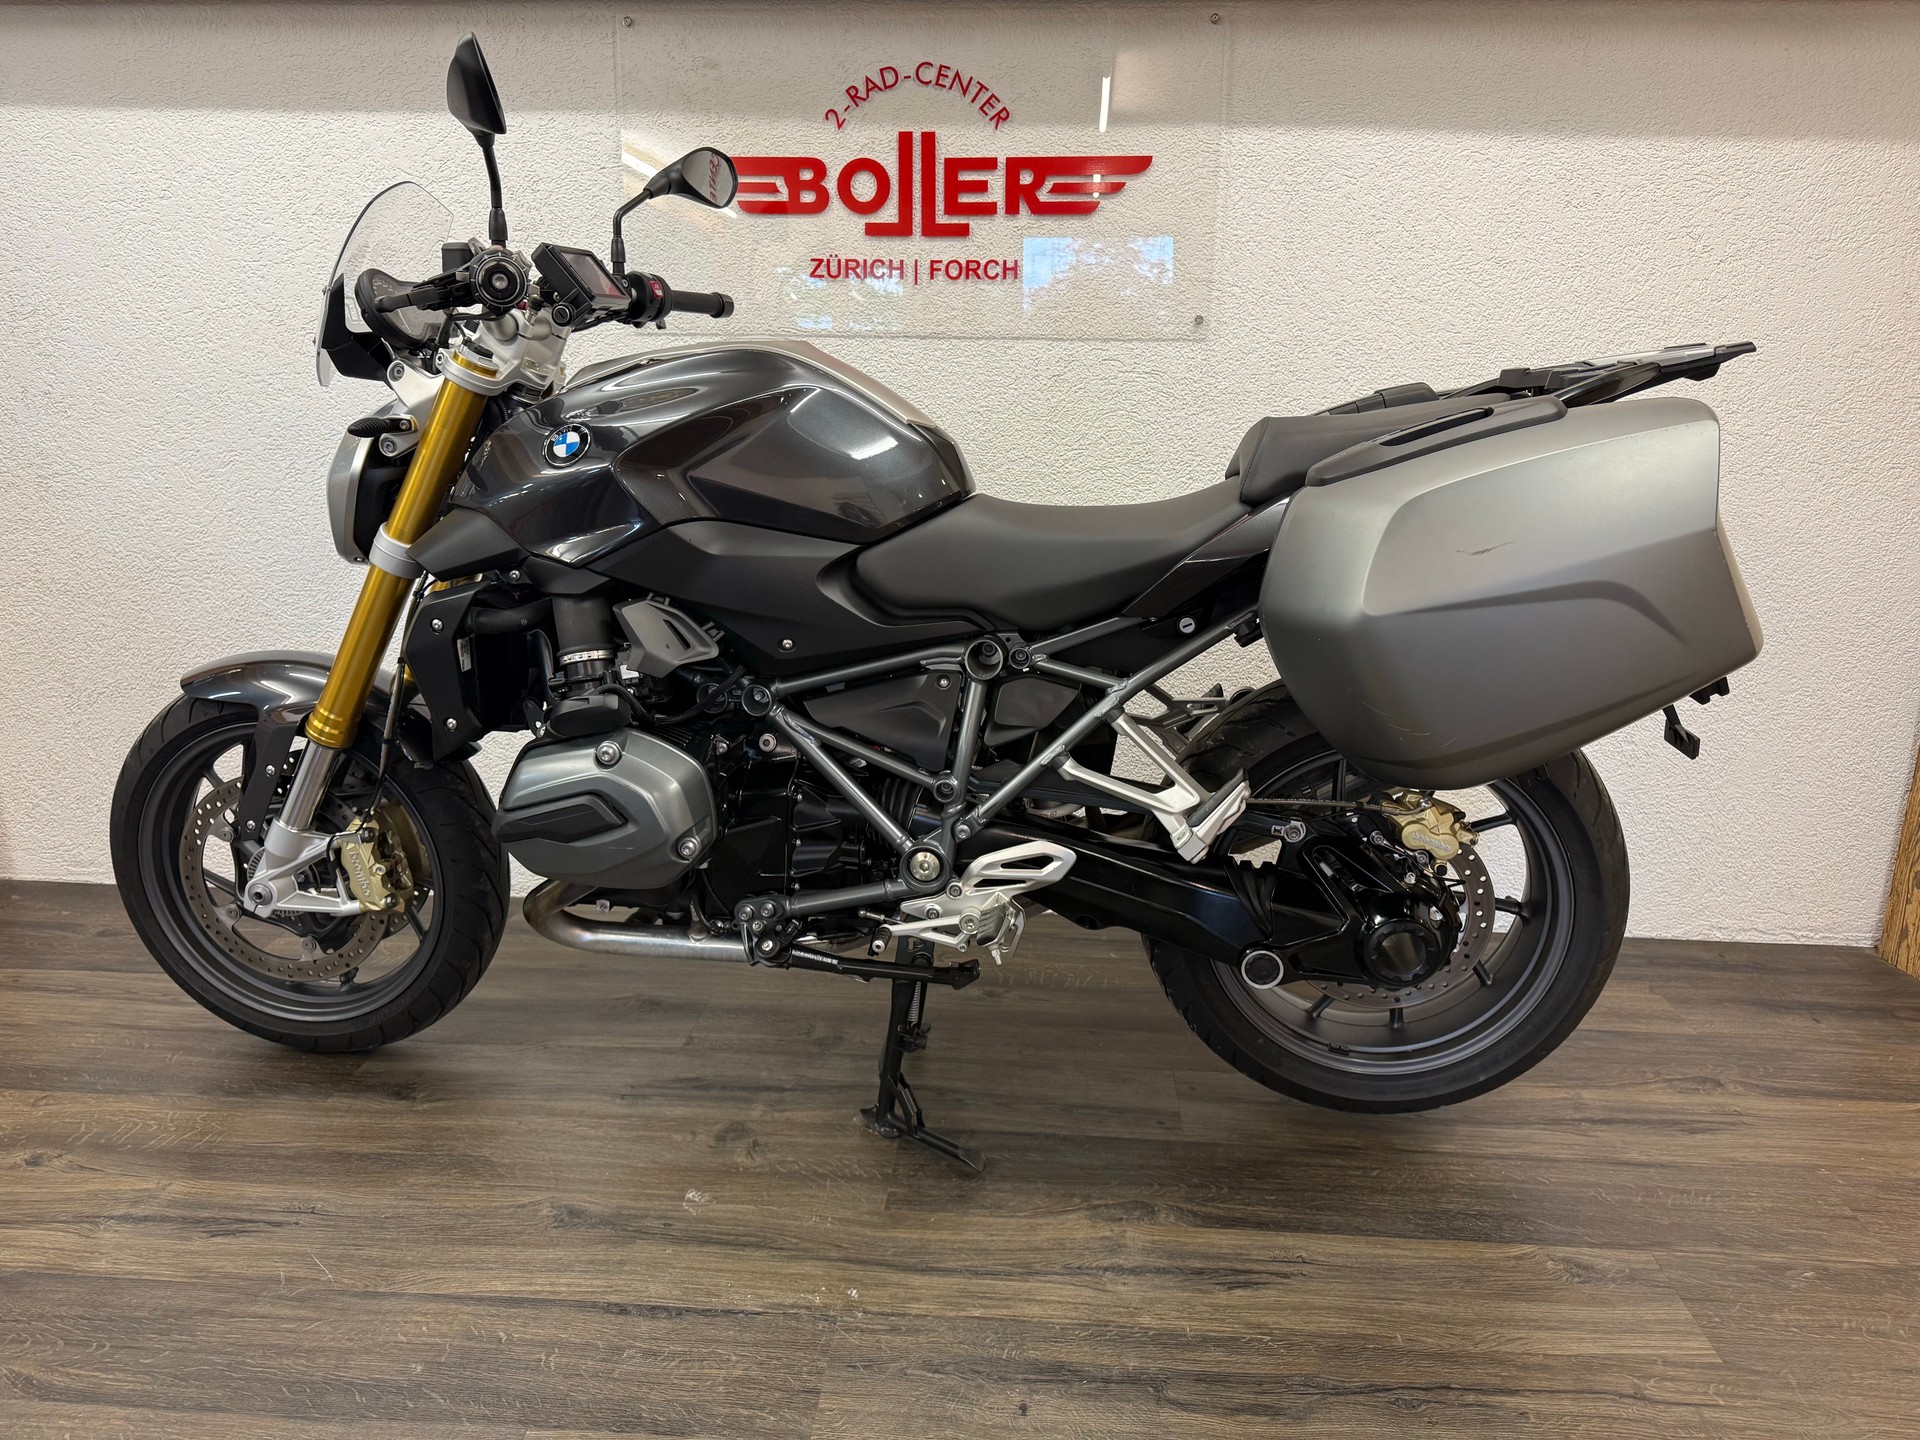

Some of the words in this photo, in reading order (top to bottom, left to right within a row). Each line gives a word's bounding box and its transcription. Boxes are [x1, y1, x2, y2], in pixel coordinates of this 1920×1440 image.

[824, 61, 1011, 129] 2-RAD-CENTER
[788, 131, 1042, 237] BOLLER
[809, 255, 905, 280] ZÜRICH
[929, 259, 1019, 281] FORCH
